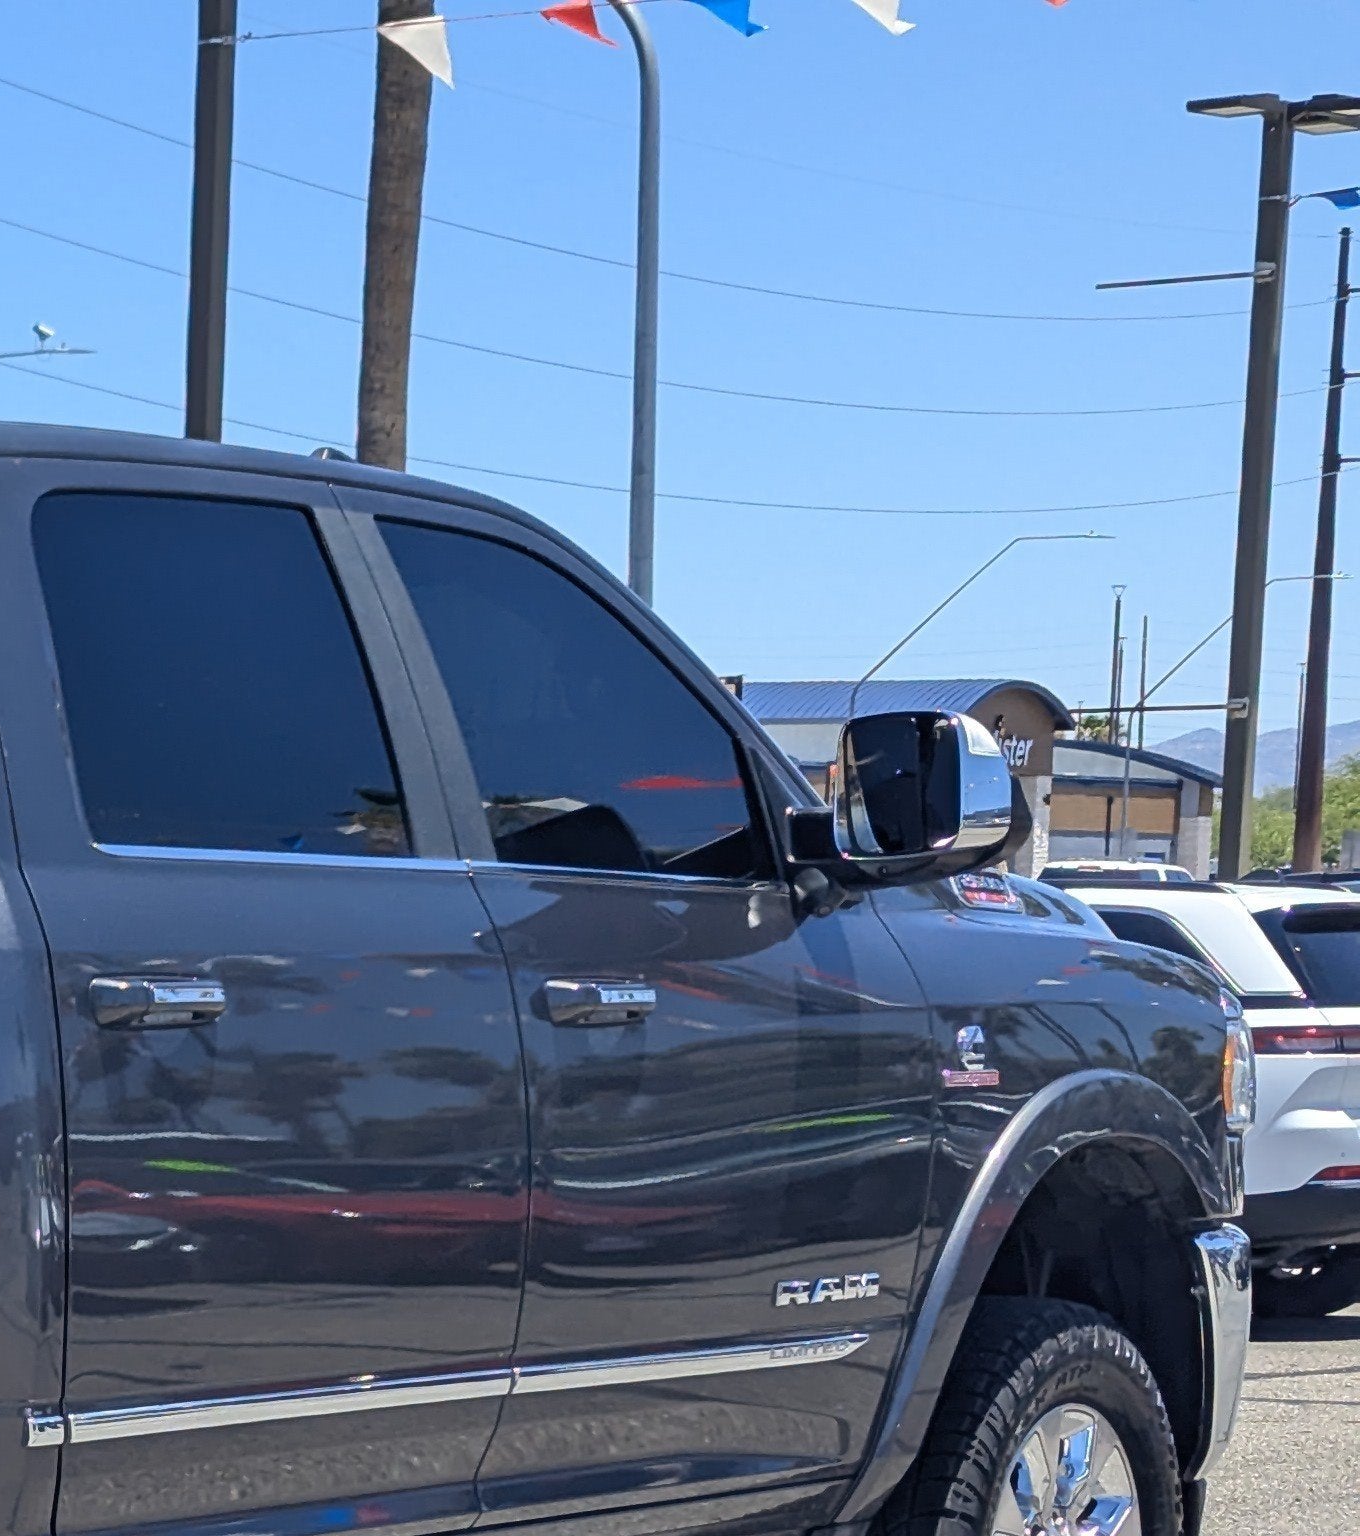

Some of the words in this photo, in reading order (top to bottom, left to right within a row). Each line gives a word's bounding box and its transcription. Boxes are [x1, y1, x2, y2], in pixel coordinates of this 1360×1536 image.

[994, 730, 1034, 767] ister
[775, 1272, 880, 1307] RAM
[770, 1341, 850, 1359] LIMITED
